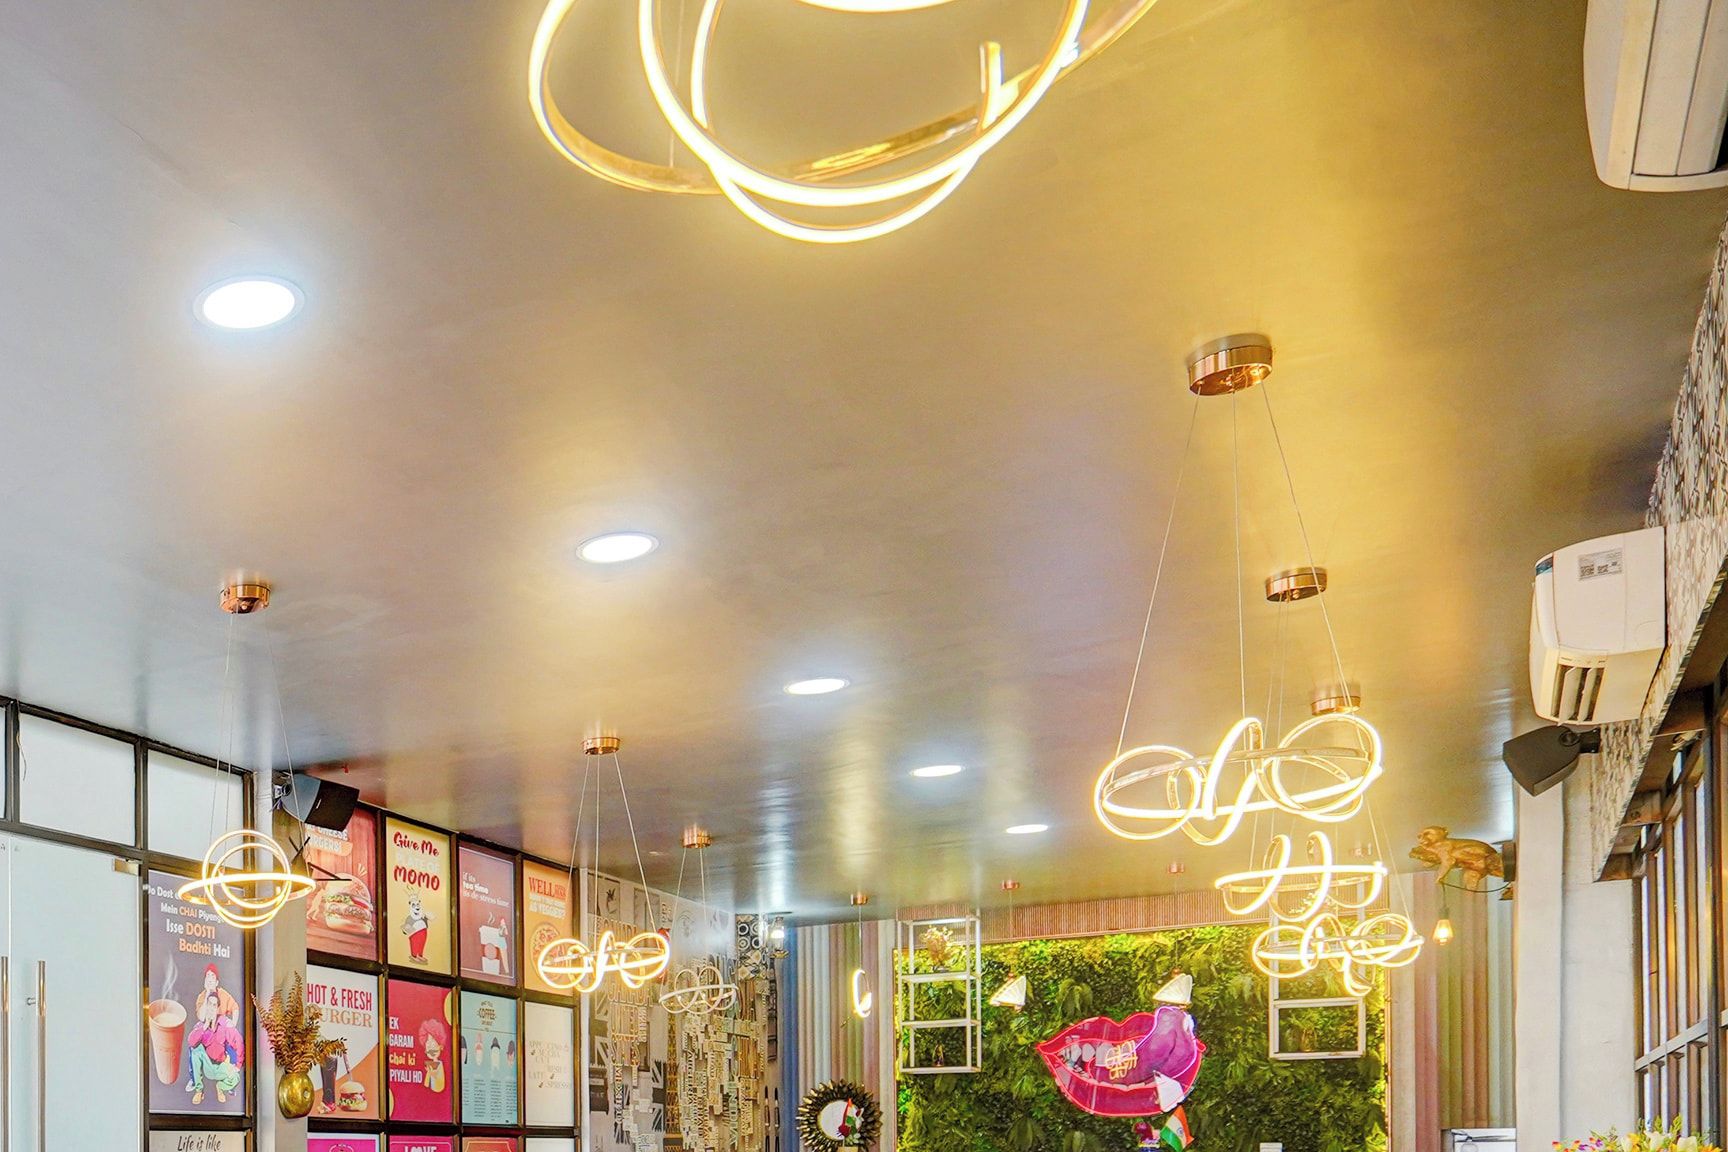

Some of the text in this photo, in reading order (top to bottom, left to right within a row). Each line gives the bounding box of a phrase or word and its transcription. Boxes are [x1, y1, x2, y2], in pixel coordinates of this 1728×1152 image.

[393, 865, 440, 890] MOMO
[166, 918, 216, 940] Isse DOSTI
[178, 938, 231, 959] Badhti Hai
[306, 983, 373, 1011] HOT & FRESH
[389, 1016, 400, 1030] EK
[389, 1034, 414, 1049] GARAM
